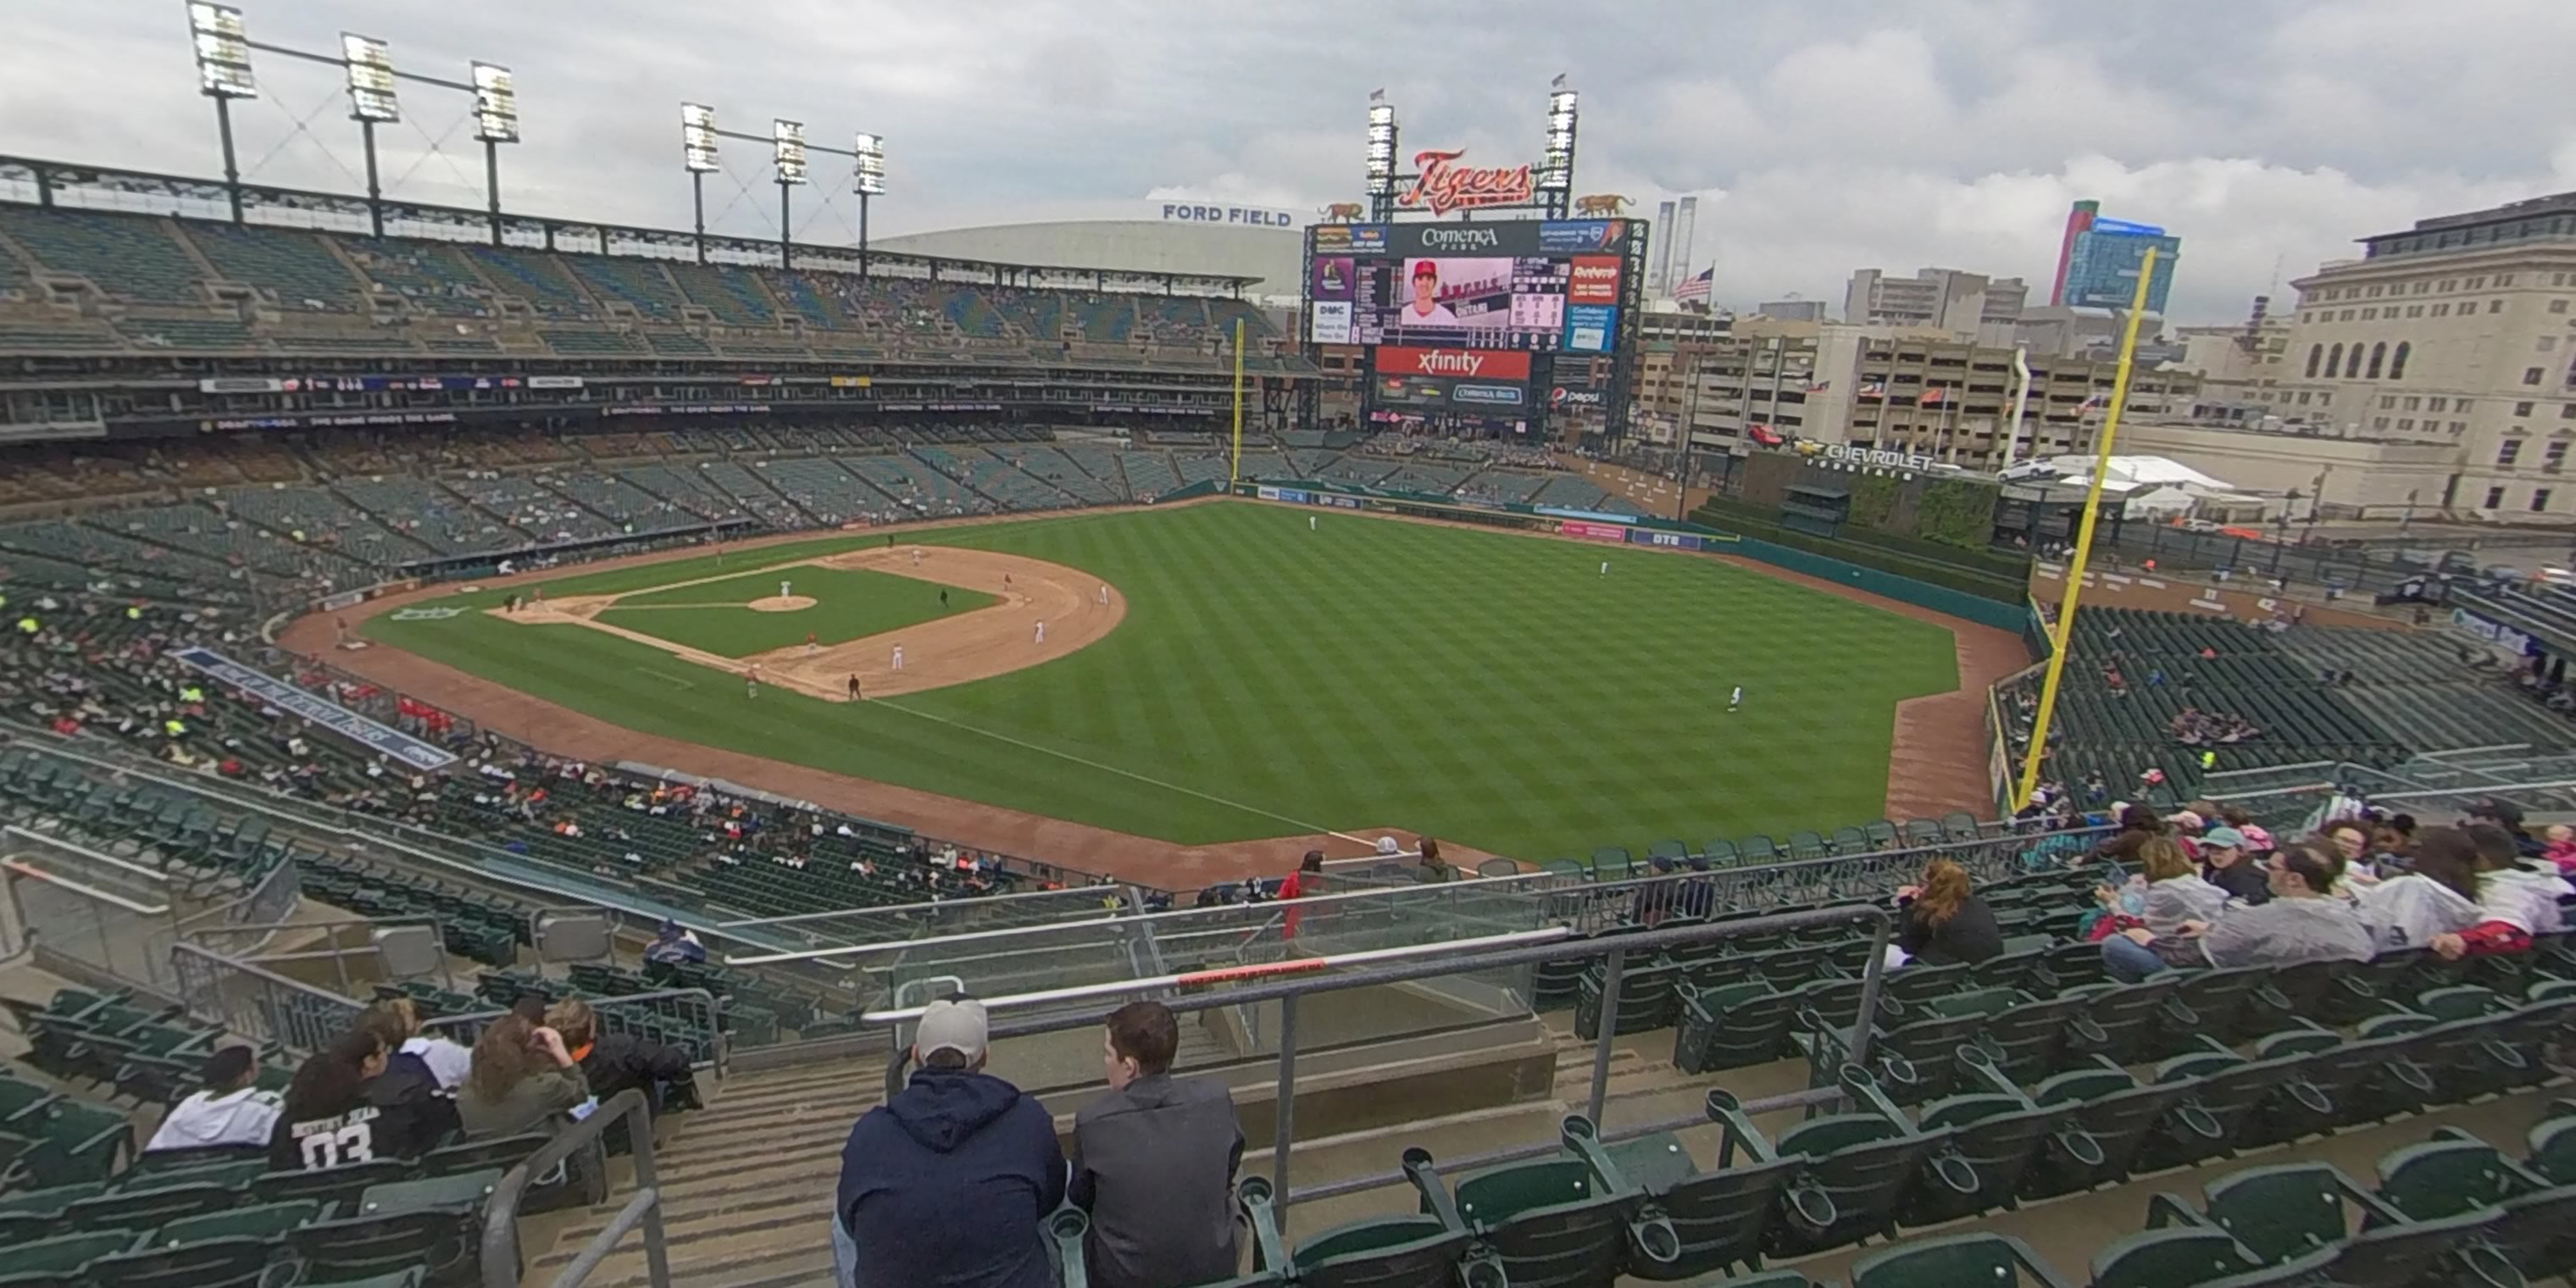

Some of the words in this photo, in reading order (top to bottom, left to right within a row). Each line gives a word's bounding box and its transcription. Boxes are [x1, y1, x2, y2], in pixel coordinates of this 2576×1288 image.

[1399, 147, 1532, 215] Tigers
[1163, 204, 1223, 222] FORD
[1229, 208, 1291, 227] FIELD
[1319, 305, 1345, 315] DMC
[1418, 350, 1485, 376] xfinity
[1567, 391, 1600, 404] pepsi
[1826, 444, 1935, 471] CHEVROLET
